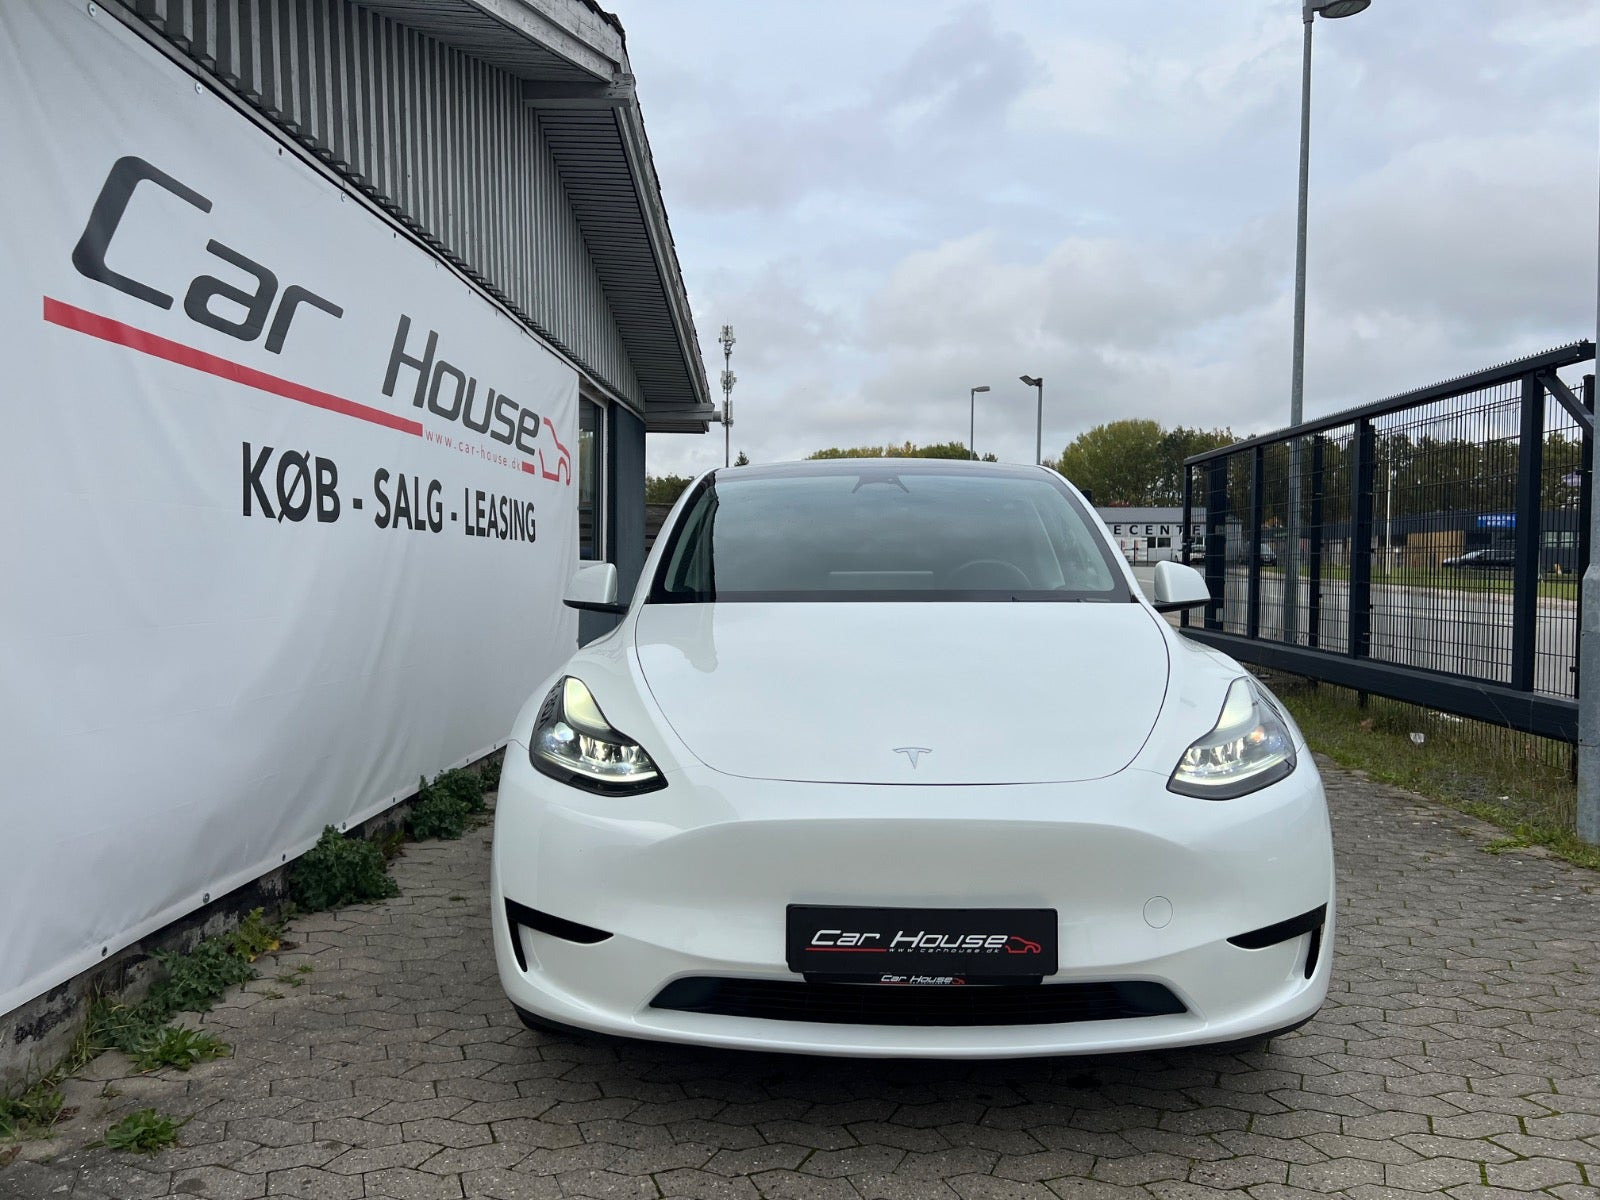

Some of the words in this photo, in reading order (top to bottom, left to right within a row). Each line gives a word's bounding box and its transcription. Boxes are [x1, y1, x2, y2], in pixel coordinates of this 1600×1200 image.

[72, 156, 343, 354] Car
[381, 314, 540, 456] House
[425, 430, 521, 471] www.car-house.dk
[242, 442, 341, 523] KØB
[374, 468, 443, 533] SALG
[465, 487, 536, 543] LEASING
[811, 929, 880, 946] Car
[889, 930, 1008, 948] House
[881, 974, 907, 982] Car
[909, 975, 953, 984] House
